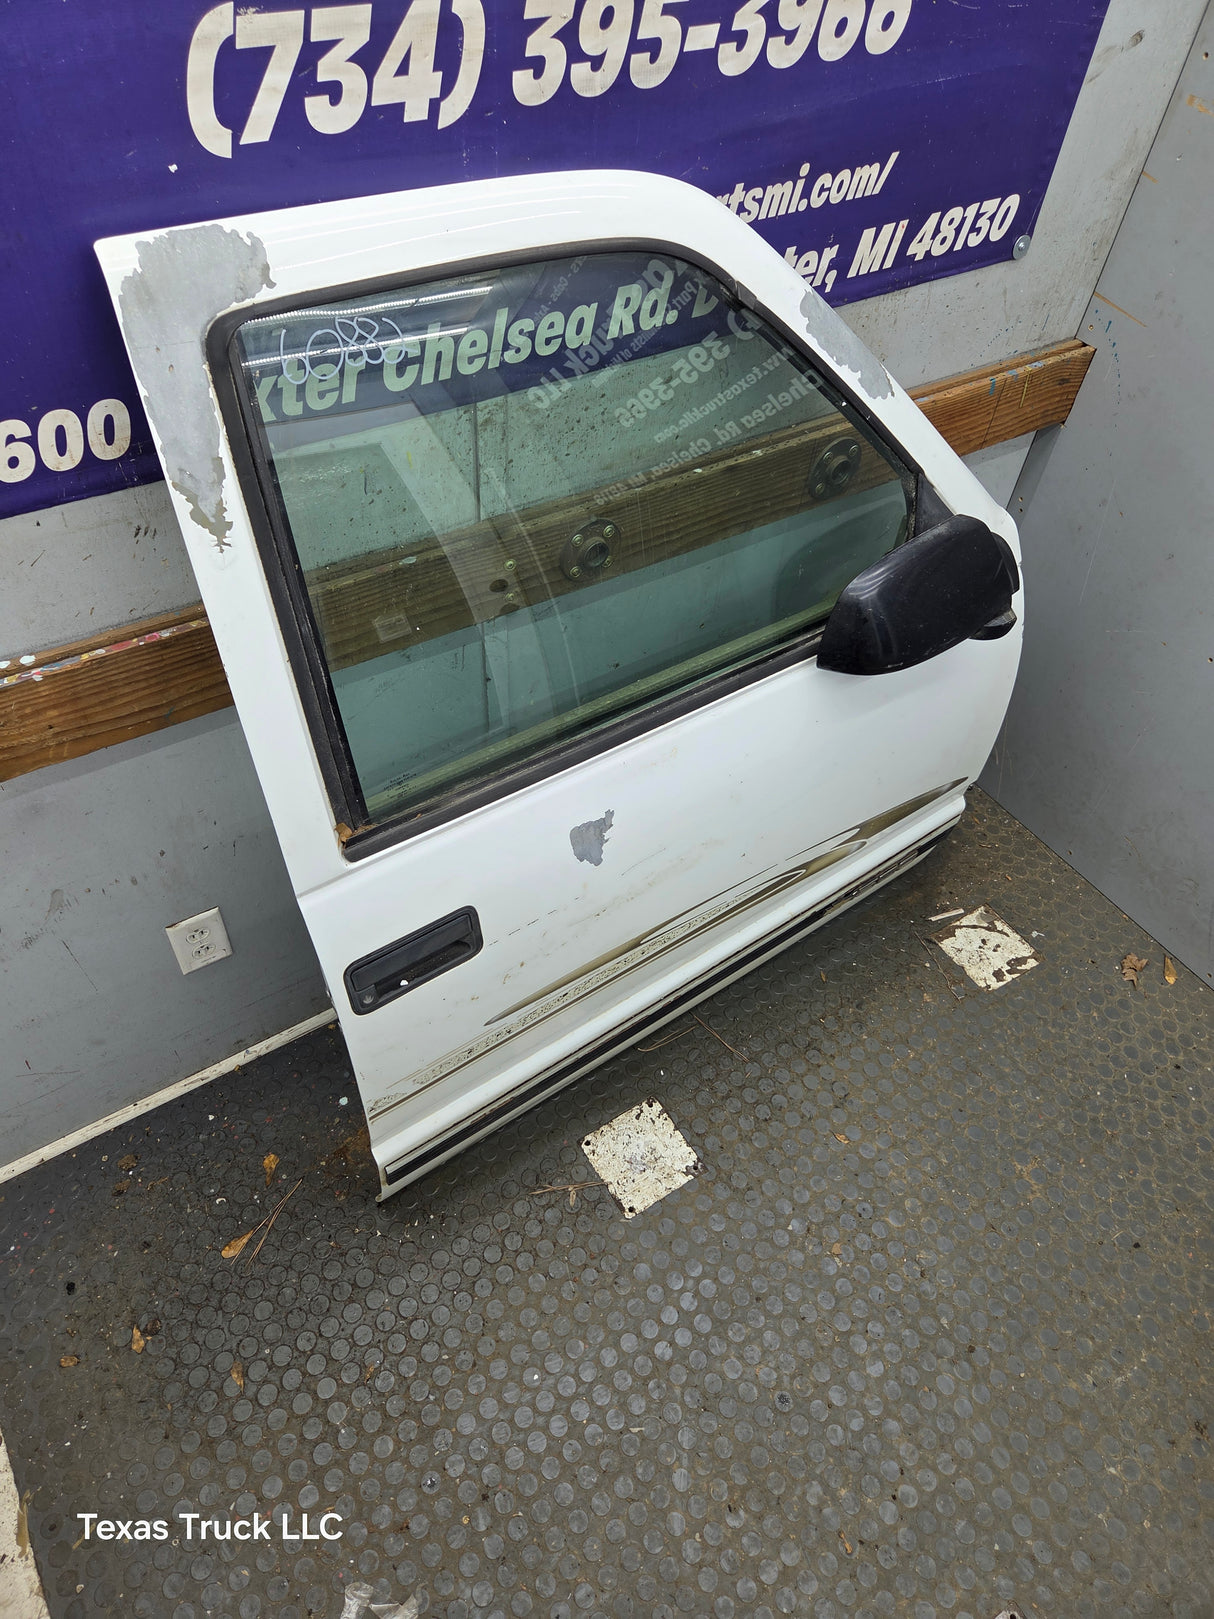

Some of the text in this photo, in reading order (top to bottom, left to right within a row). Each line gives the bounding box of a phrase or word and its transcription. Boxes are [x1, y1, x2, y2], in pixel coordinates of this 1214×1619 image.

[186, 0, 483, 158] (734)
[0, 398, 132, 484] 600
[382, 302, 598, 392] Chelsea
[607, 269, 679, 340] Rd.
[846, 219, 910, 279] MI
[906, 193, 1020, 262] 48130
